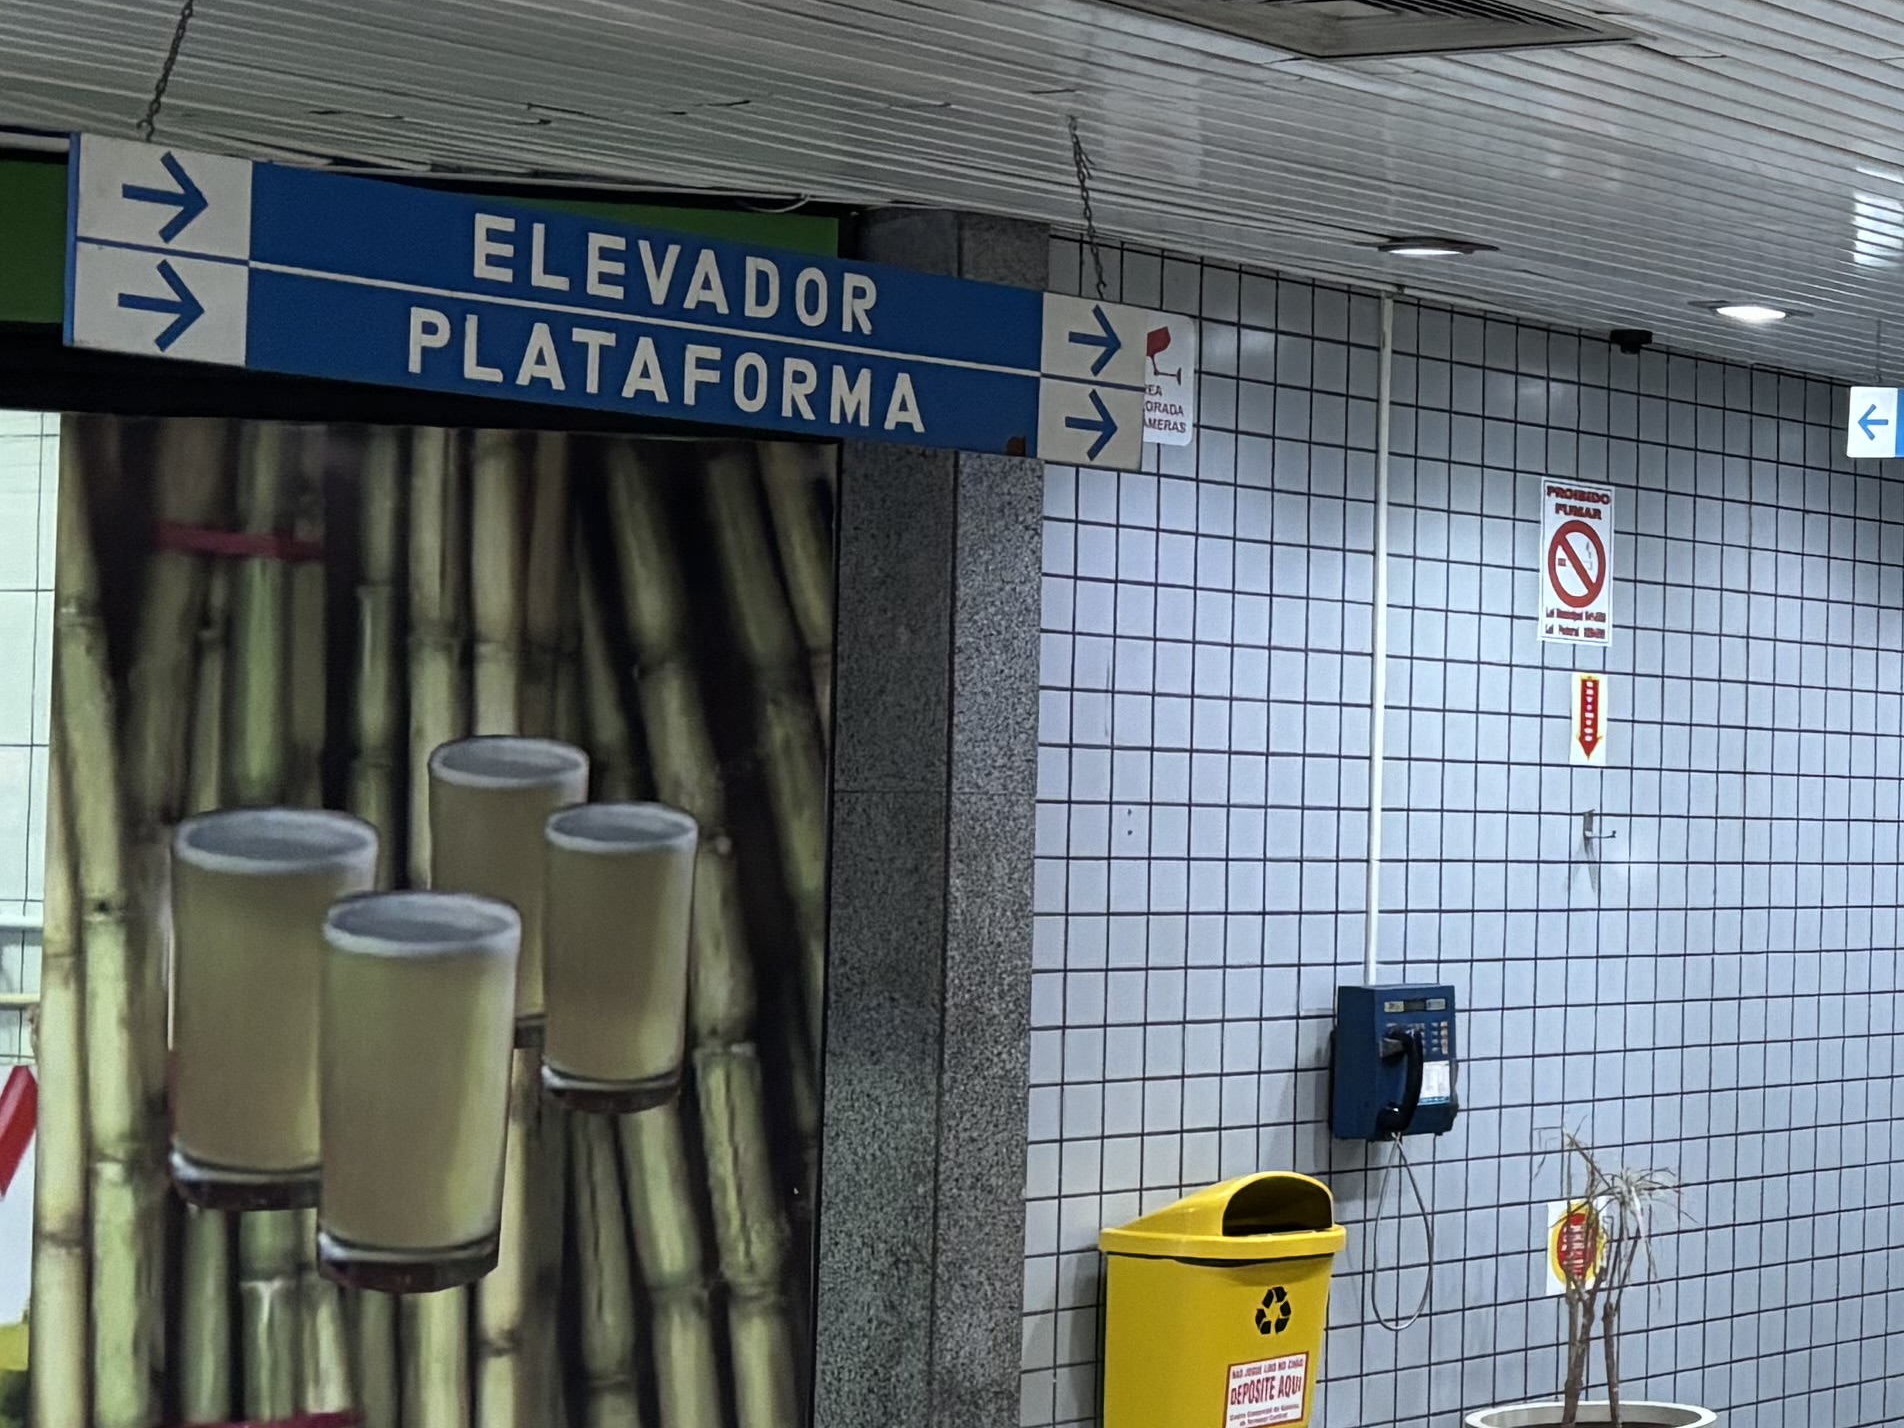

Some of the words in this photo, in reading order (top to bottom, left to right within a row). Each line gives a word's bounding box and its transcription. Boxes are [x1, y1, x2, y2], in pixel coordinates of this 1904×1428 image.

[473, 212, 878, 335] ELEVADOR
[407, 306, 925, 434] PLATAFORMA
[1145, 400, 1185, 417] ORADA
[1547, 485, 1611, 505] PROIBIDO
[1555, 503, 1602, 520] FUMAR
[1230, 1376, 1276, 1405] DEPOSITE
[1277, 1375, 1302, 1398] AQUI
